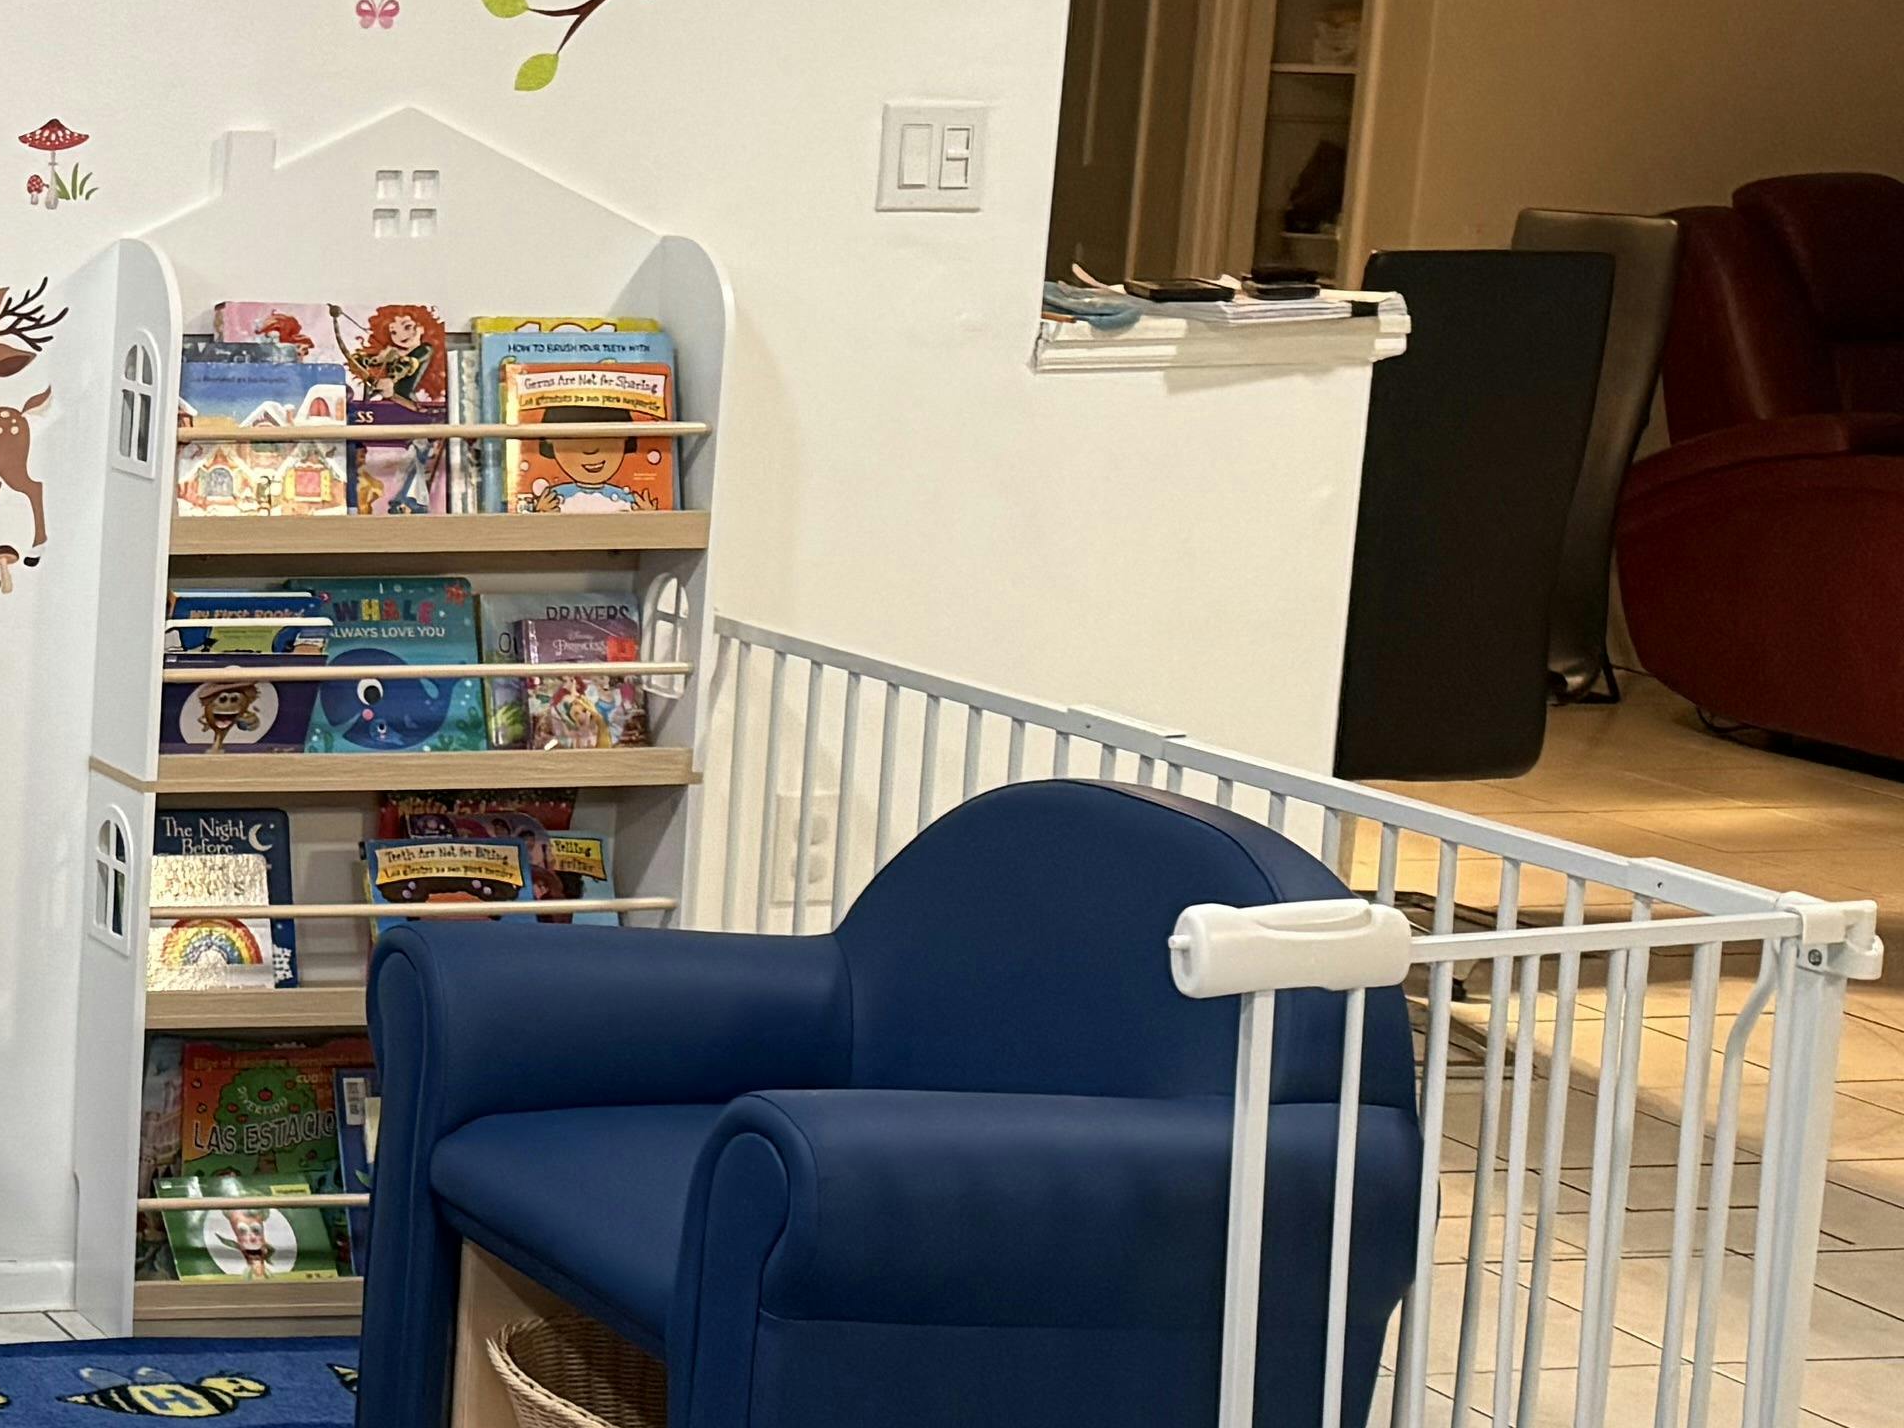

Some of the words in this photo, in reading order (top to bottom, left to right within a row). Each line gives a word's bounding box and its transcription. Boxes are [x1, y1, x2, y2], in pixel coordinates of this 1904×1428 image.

[507, 343, 530, 354] HOW
[532, 343, 545, 353] TO
[546, 343, 577, 354] BRUSH
[524, 376, 556, 390] Germs
[558, 375, 576, 387] Are
[578, 373, 598, 387] Not
[615, 375, 659, 396] Sharing
[333, 597, 436, 624] WHALE
[381, 626, 415, 638] LOVE
[417, 626, 446, 638] YOU
[161, 816, 193, 839] The
[199, 817, 248, 843] Night
[181, 837, 235, 856] Before
[384, 847, 416, 864] Teeth
[417, 846, 435, 859] Are
[437, 845, 458, 859] Not
[554, 839, 594, 859] Yelling
[192, 1120, 238, 1156] LAS
[243, 1109, 338, 1156] ESTACIO
[147, 1386, 205, 1413] H
